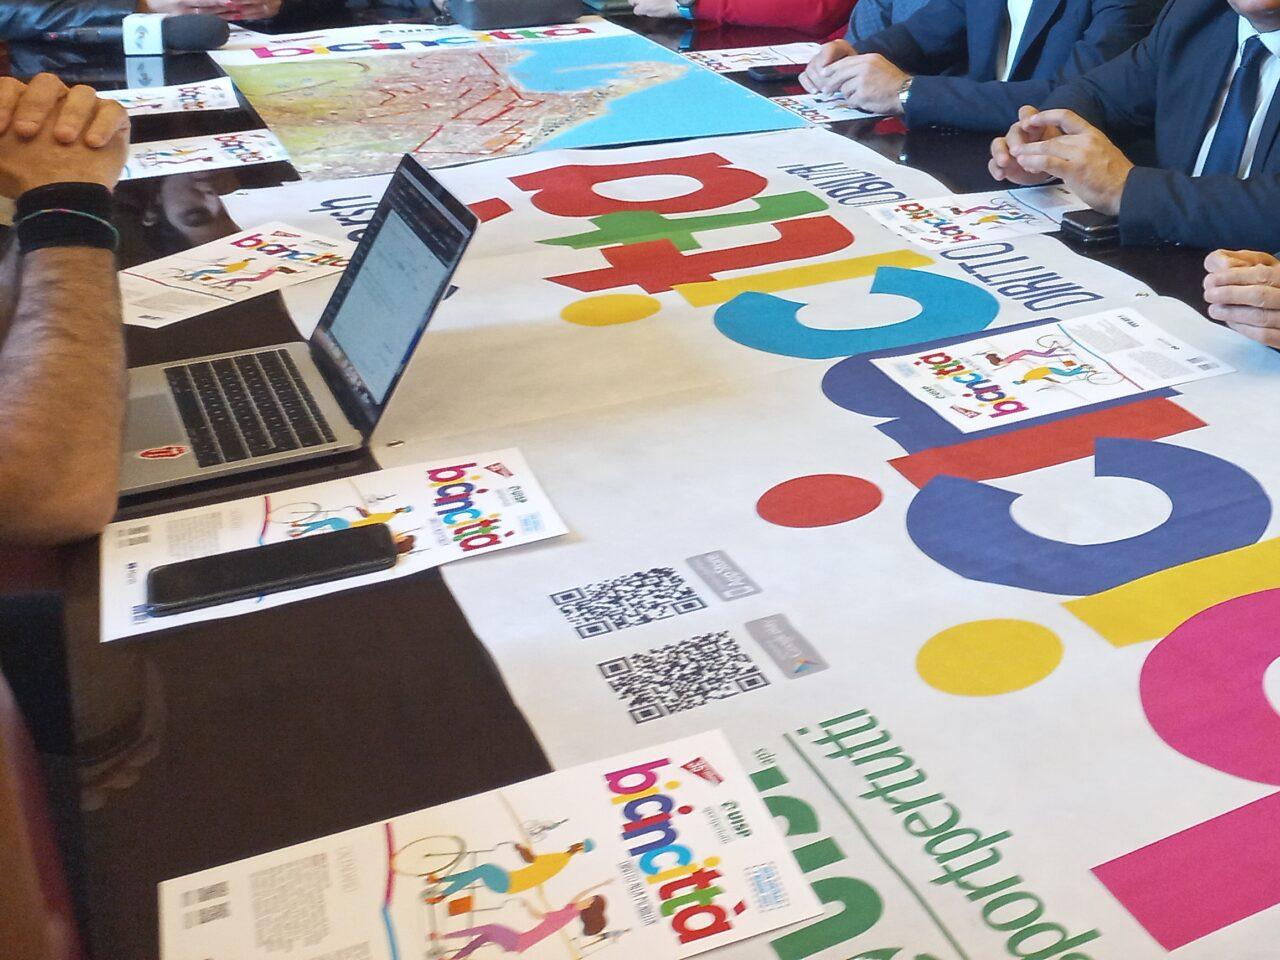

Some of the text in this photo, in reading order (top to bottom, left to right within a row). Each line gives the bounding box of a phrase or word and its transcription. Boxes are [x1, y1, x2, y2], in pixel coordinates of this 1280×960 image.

[940, 242, 1104, 313] DIRITTO
[914, 351, 1030, 419] bicincittà
[426, 462, 515, 552] bicincittà
[603, 757, 747, 945] bicincittà
[796, 708, 1101, 960] portpertutti
